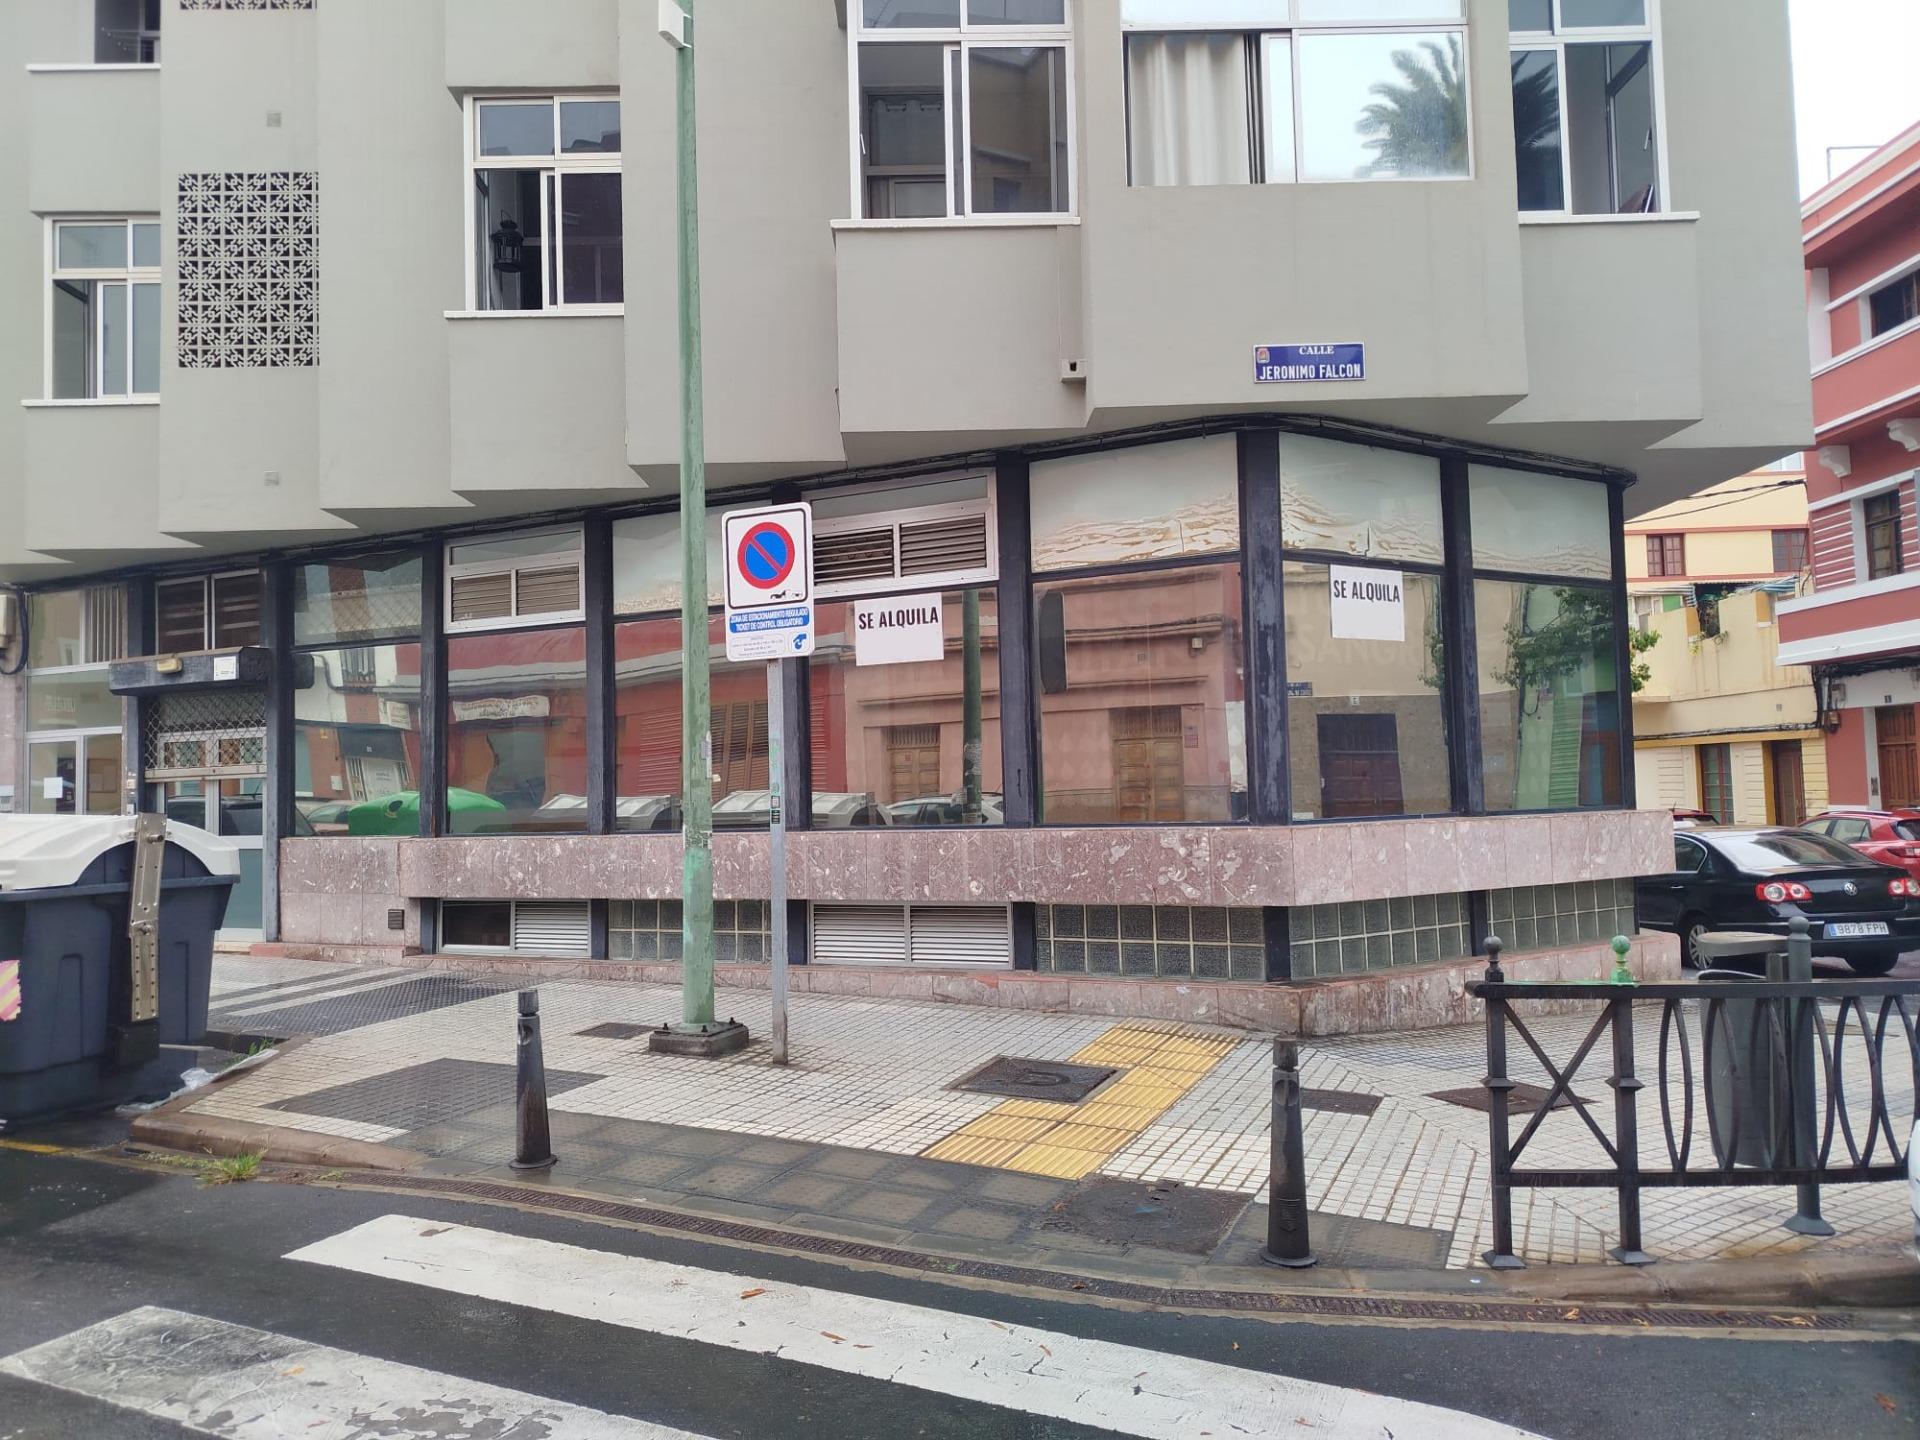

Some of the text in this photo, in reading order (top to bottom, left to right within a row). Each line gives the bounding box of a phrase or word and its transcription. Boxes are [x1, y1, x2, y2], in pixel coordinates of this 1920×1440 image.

[1299, 346, 1334, 355] CALLE
[1260, 363, 1361, 380] JERONIMO FALCON
[1333, 579, 1347, 598] SE
[1352, 581, 1400, 603] ALQUILA
[742, 613, 748, 621] DE
[858, 606, 939, 630] SE ALQUILA
[751, 622, 757, 630] DE
[1837, 922, 1888, 935] 9878 FPH
